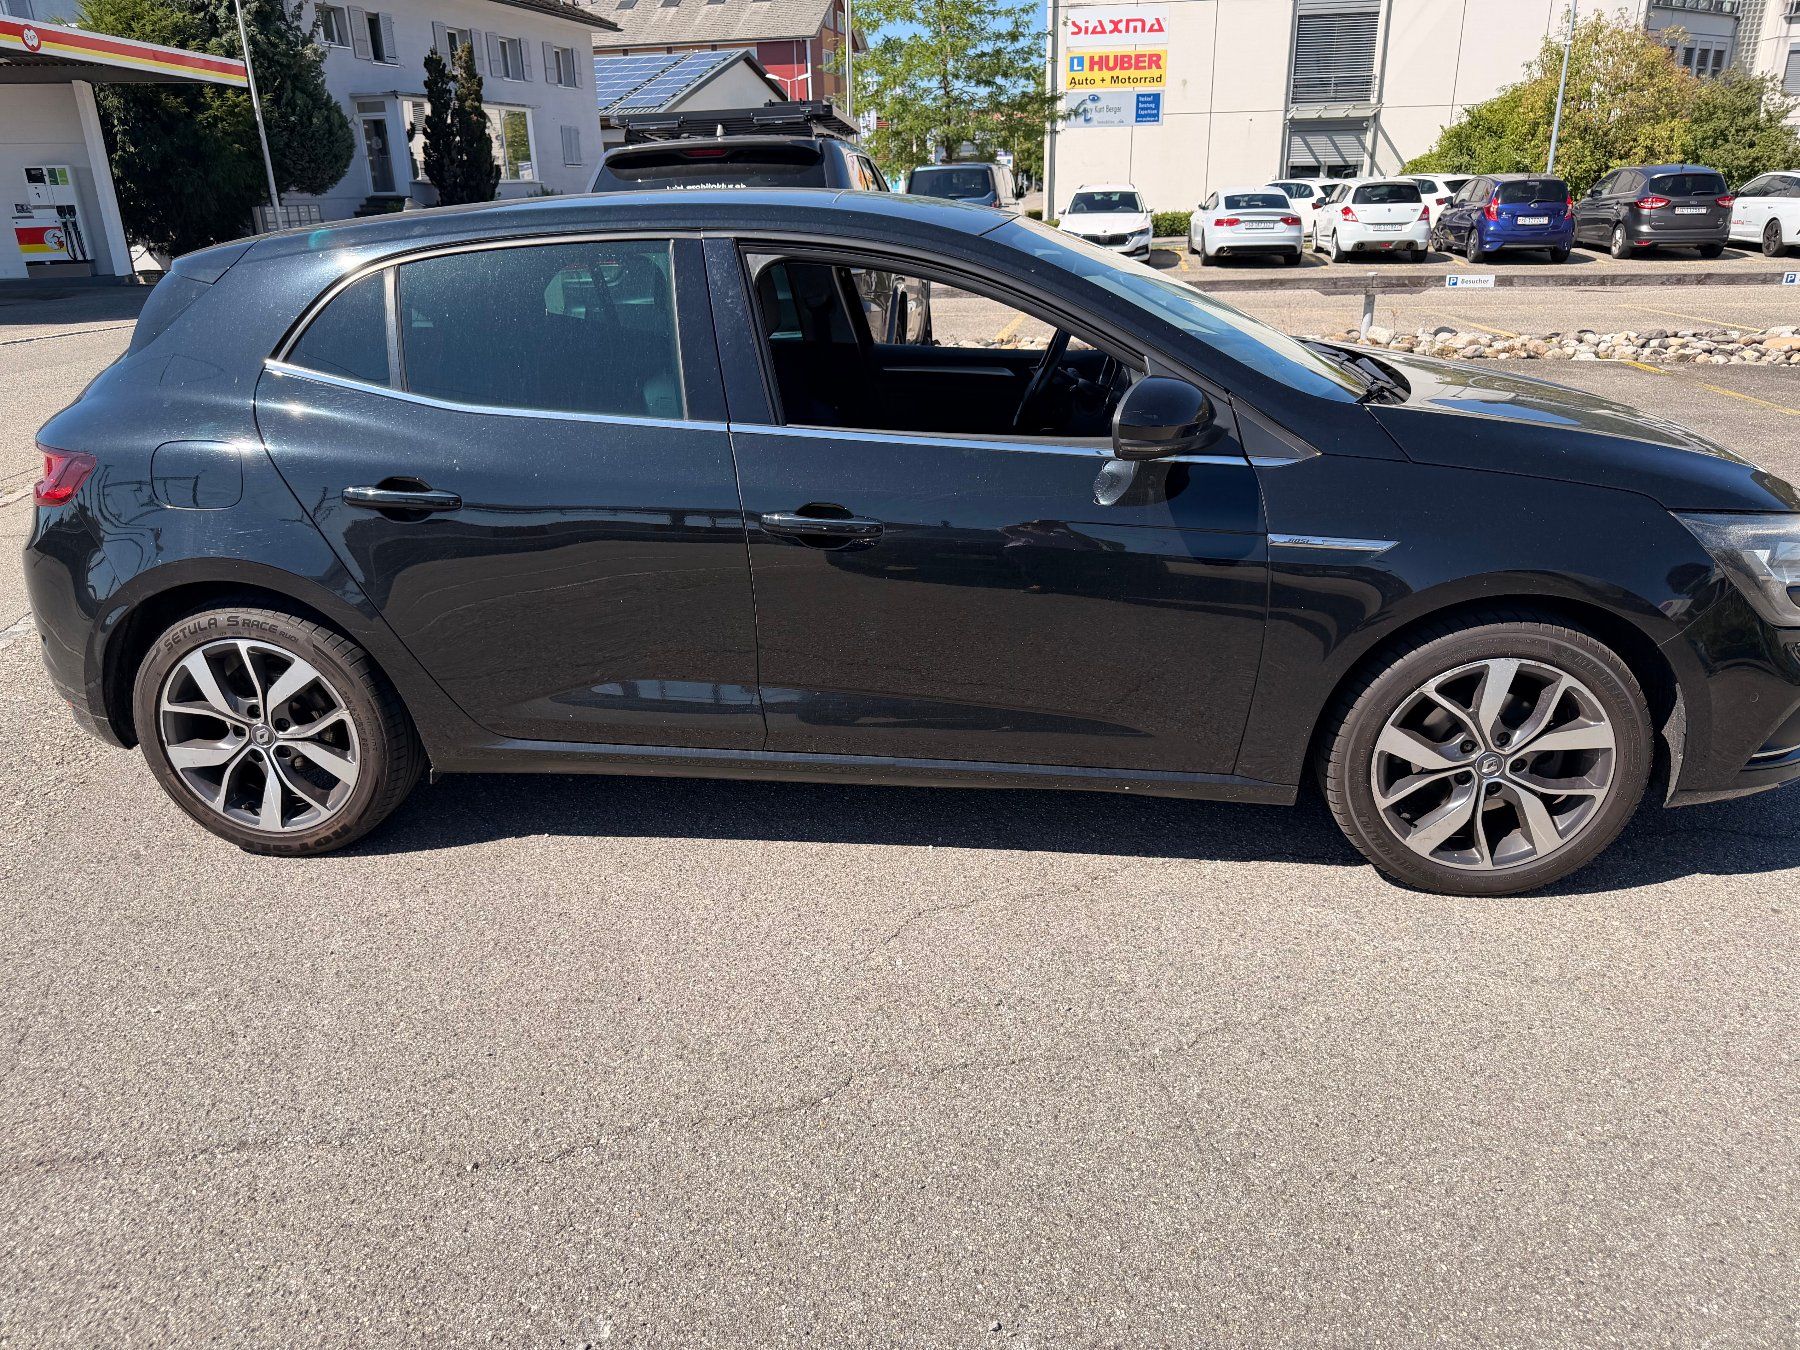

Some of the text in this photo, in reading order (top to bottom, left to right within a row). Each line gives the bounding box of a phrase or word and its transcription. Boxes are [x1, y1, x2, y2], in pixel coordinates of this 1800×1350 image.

[1073, 53, 1162, 71] L HUBER
[1070, 77, 1096, 86] Auto
[1110, 74, 1162, 84] Motorrad
[1106, 104, 1121, 114] Berger
[164, 617, 218, 652] SETULA
